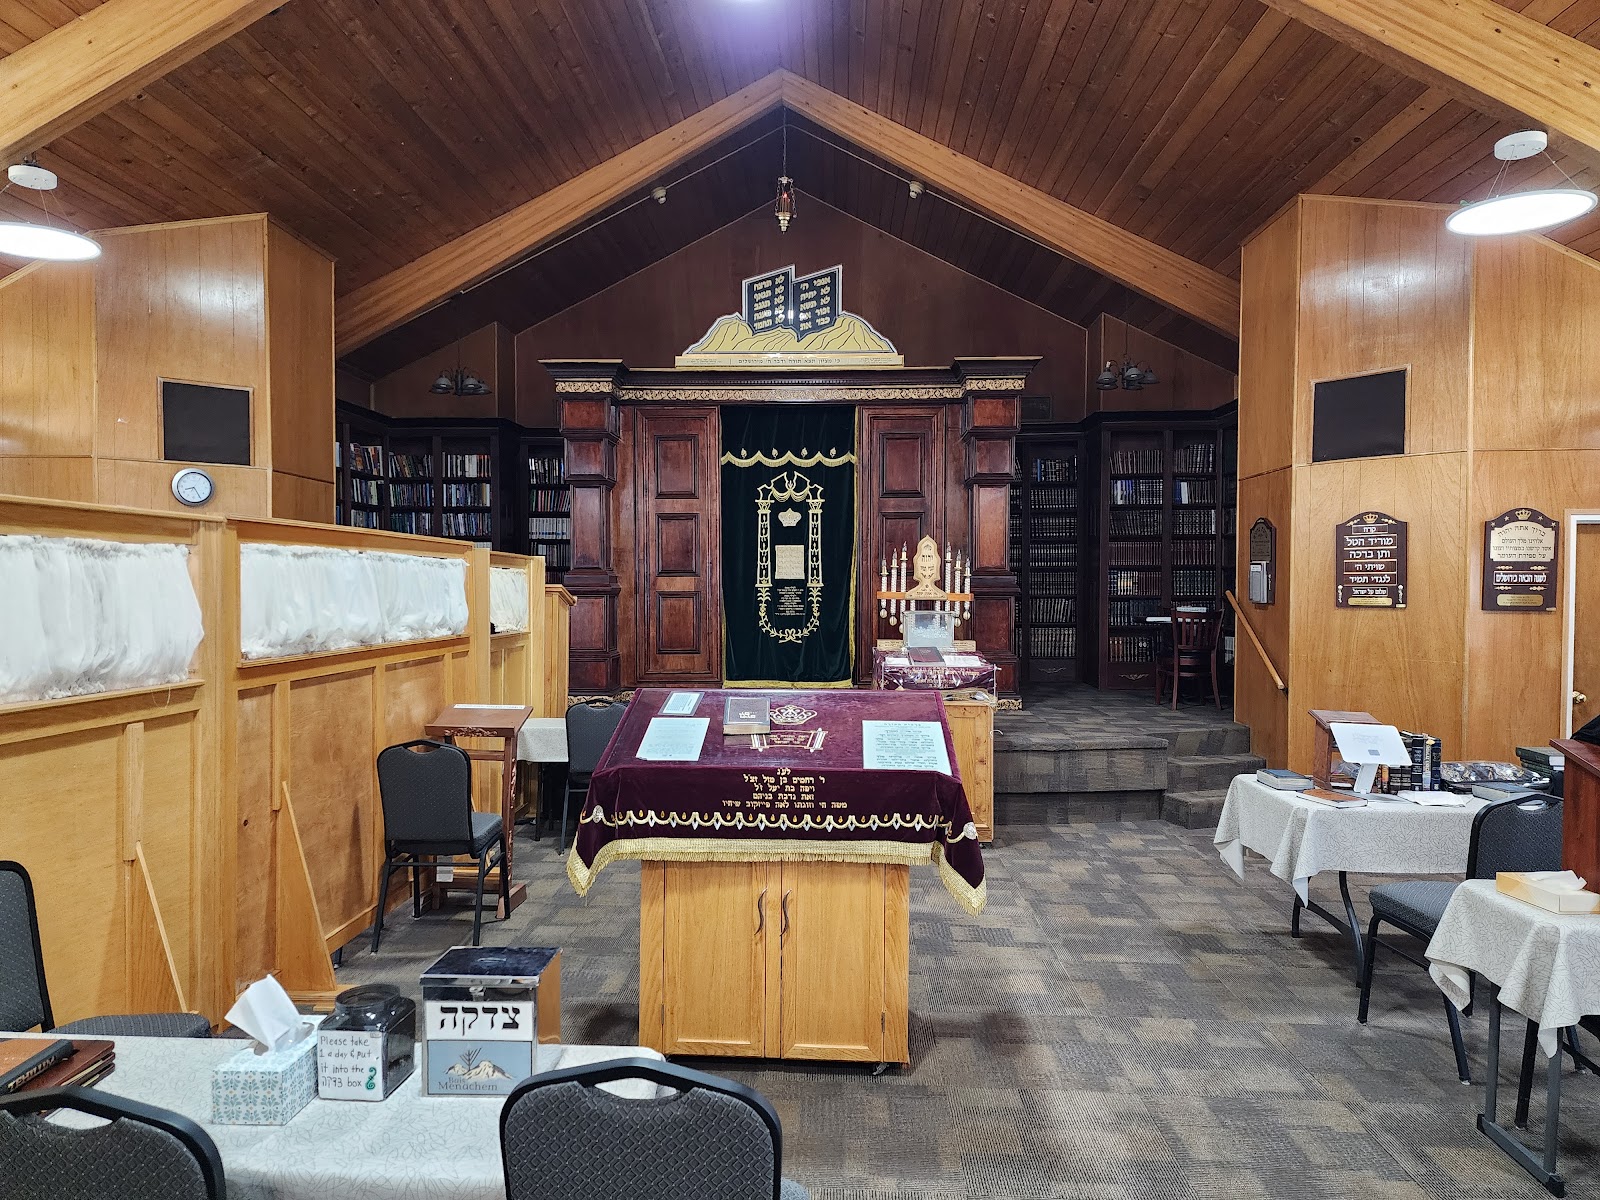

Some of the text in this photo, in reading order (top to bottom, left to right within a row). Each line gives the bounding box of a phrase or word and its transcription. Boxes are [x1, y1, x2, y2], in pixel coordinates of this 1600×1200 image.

[754, 274, 785, 291] לא תרצח
[775, 285, 785, 295] לא
[820, 285, 831, 295] לא
[774, 294, 785, 305] לא
[800, 295, 831, 311] לא תשא
[1531, 526, 1547, 537] ברוך
[1345, 537, 1394, 547] מוריד הטל
[1349, 549, 1391, 560] ותן ברכה
[1364, 563, 1385, 571] שויתי
[1348, 574, 1391, 583] לנגדי תמיד
[1495, 572, 1547, 583] לשנה הבאה בירושלים
[779, 776, 788, 786] בן
[792, 776, 815, 784] רחמים
[784, 784, 796, 792] בת
[774, 800, 790, 809] לאה
[830, 801, 848, 809] משה
[440, 1005, 520, 1036] צדקה
[320, 1035, 370, 1047] Please take
[319, 1048, 325, 1058] 1
[334, 1049, 348, 1060] day
[356, 1049, 372, 1060] put
[320, 1062, 365, 1074] it into the
[347, 1076, 363, 1087] box
[438, 1081, 498, 1091] Menachem
